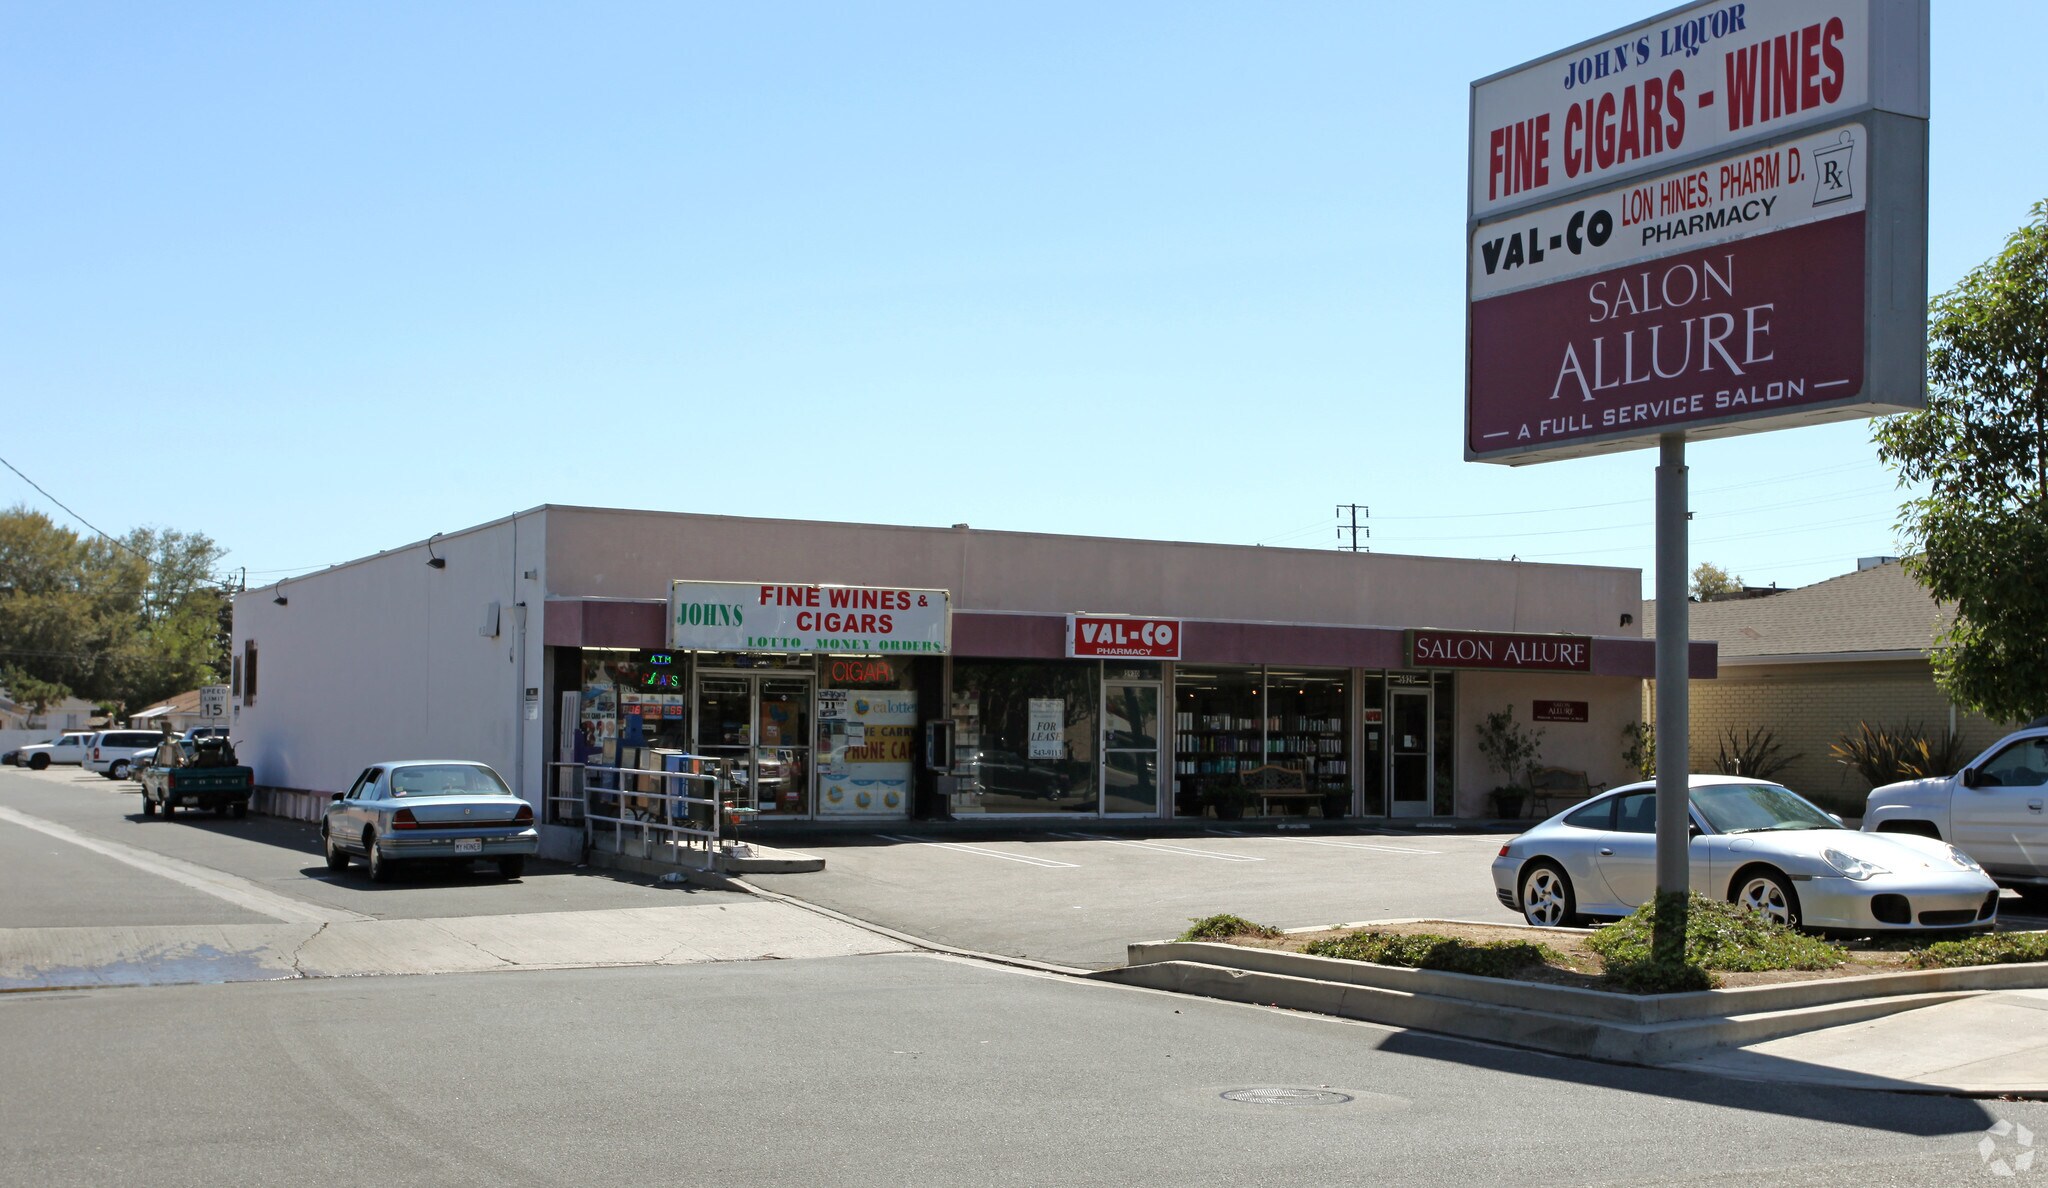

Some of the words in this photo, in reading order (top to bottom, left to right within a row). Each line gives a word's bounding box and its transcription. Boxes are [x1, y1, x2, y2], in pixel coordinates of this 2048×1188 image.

[1564, 35, 1650, 91] JOHN'S
[1661, 3, 1747, 58] LIQUOR
[1489, 113, 1550, 201] FINE
[1564, 69, 1685, 179] CIGARS
[1726, 16, 1845, 132] WINES
[1622, 188, 1653, 227] LON
[1660, 172, 1712, 217] HINES,
[1720, 152, 1780, 201] PHARM
[1788, 147, 1805, 184] D.
[1642, 196, 1777, 247] PHARMACY
[1589, 254, 1735, 324] SALON
[1550, 303, 1775, 402] ALLURE
[1517, 423, 1531, 440] A
[1540, 412, 1593, 437] FULL
[1602, 394, 1704, 426] SERVICE
[1715, 378, 1805, 409] SALON
[760, 585, 821, 607] FINE
[828, 588, 911, 610] WINES
[917, 594, 928, 607] &
[677, 602, 743, 627] JOHNS
[796, 611, 893, 634] CIGARS
[748, 636, 801, 648] LOTTO
[816, 638, 872, 650] MONEY
[878, 640, 941, 651] ORDERS
[1096, 647, 1152, 656] PHARMACY
[1417, 637, 1493, 660] SALON
[1504, 641, 1585, 666] ALLURE
[650, 654, 672, 664] ATM
[205, 703, 223, 716] 15
[1031, 732, 1062, 741] LEASE
[1036, 722, 1057, 731] FOR
